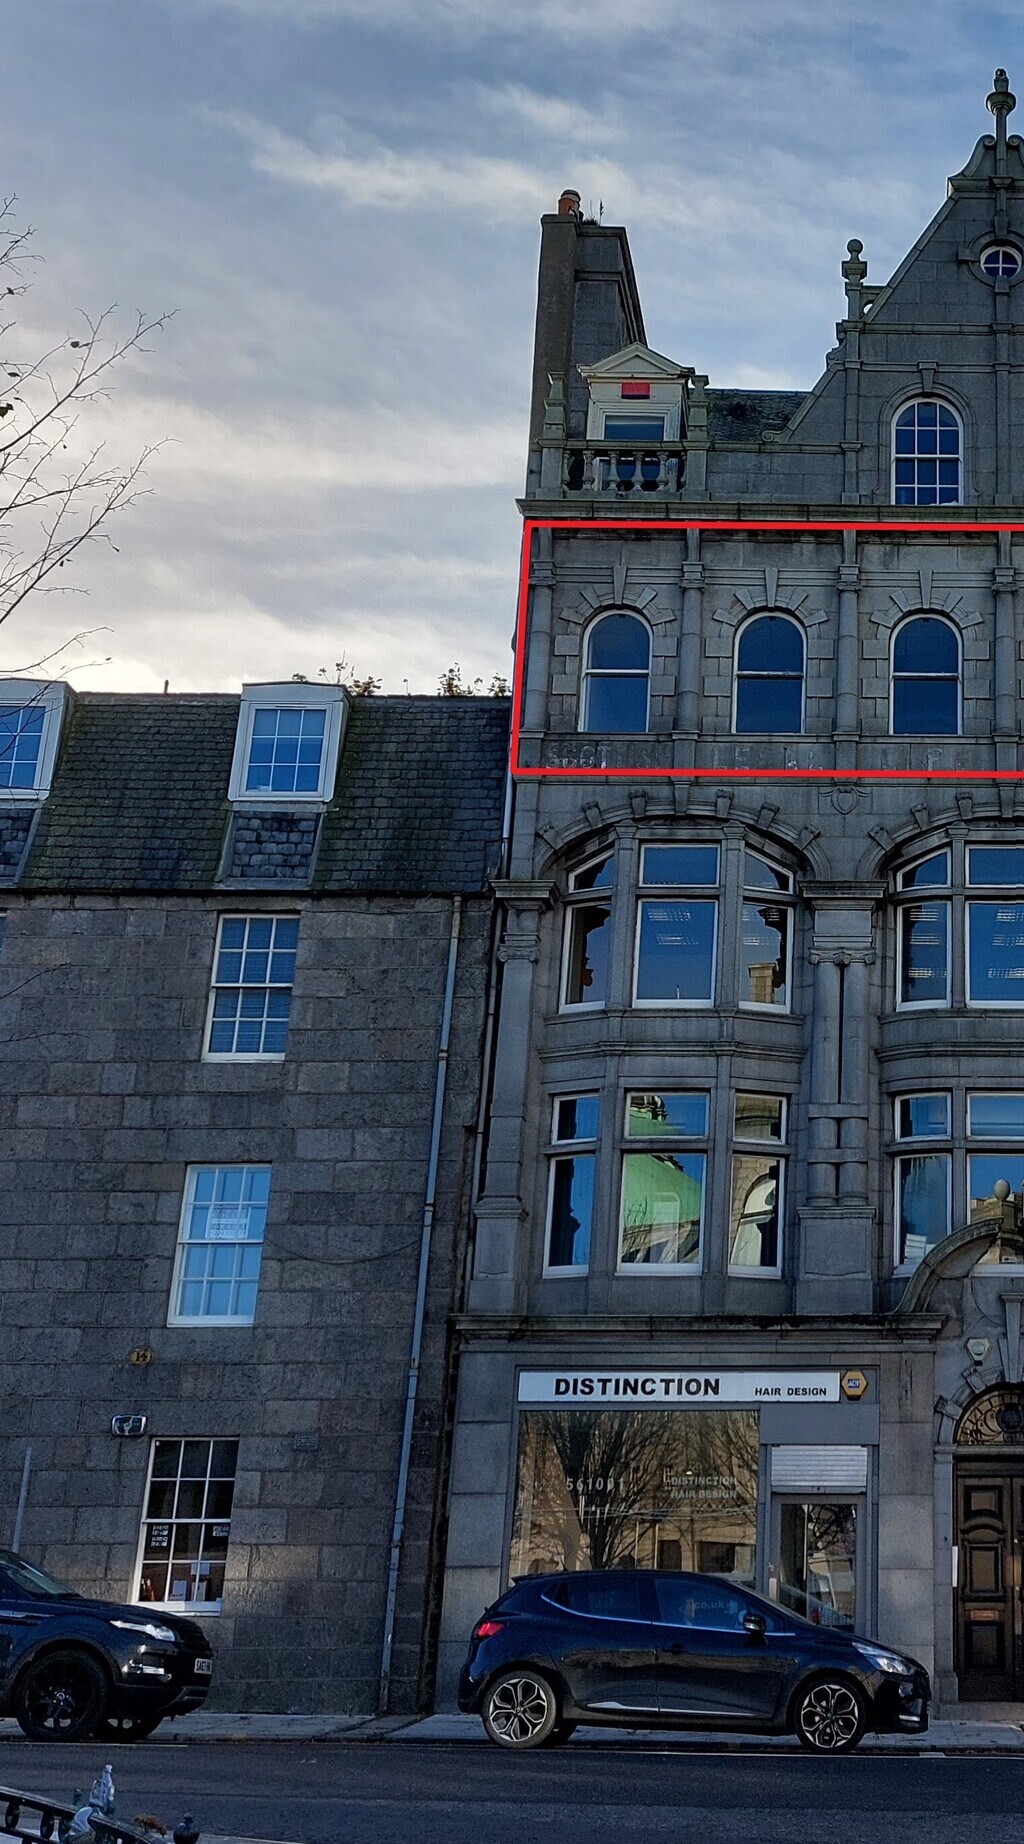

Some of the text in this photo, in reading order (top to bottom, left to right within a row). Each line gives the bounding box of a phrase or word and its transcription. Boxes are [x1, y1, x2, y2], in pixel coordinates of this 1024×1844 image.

[554, 1377, 720, 1397] DISTINCTION
[754, 1387, 827, 1397] HAIR DESIGN
[671, 1476, 737, 1486] DISTINCTION
[671, 1489, 737, 1499] HAIR DESIGN
